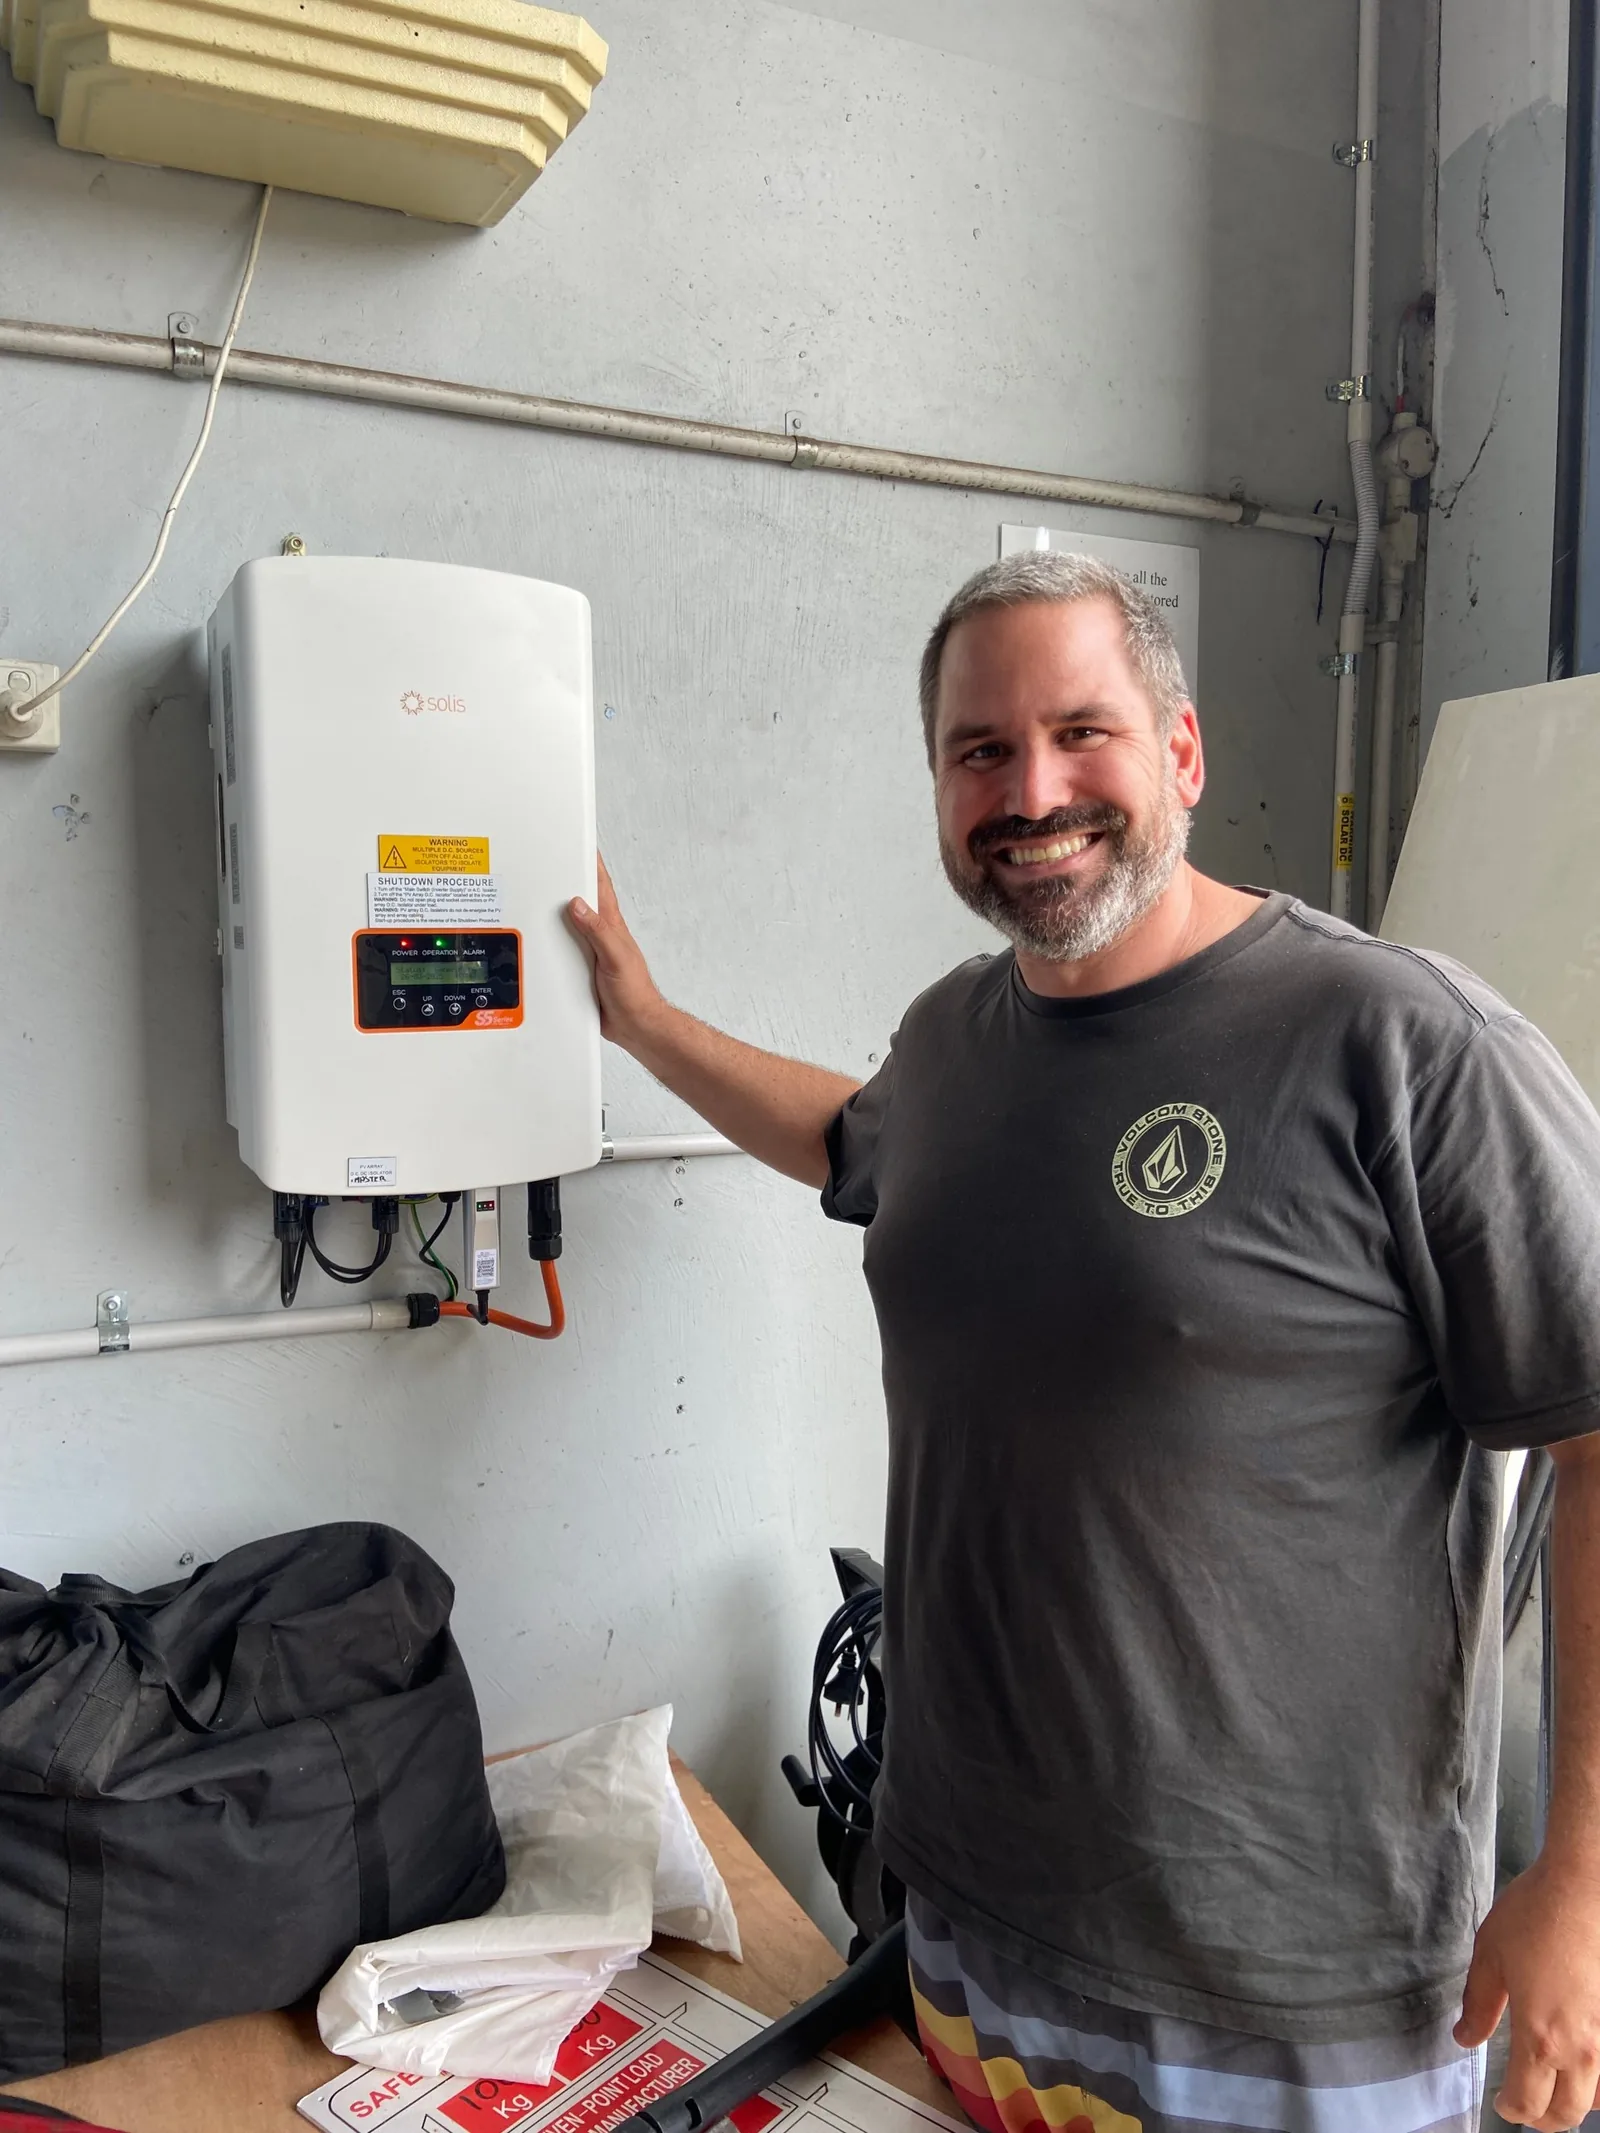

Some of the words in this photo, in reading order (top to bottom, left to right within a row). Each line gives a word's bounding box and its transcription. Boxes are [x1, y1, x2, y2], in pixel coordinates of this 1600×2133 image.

[1132, 570, 1147, 584] all
[1150, 572, 1168, 586] the
[1150, 594, 1179, 608] tored
[427, 693, 466, 713] solis
[1339, 809, 1350, 845] SOLAR
[428, 838, 468, 847] WARNING
[1338, 847, 1348, 862] DC
[378, 877, 433, 886] SHUTDOWN
[436, 878, 494, 887] PROCEDURE
[1117, 1104, 1187, 1154] VOLCOM
[1192, 1108, 1224, 1166] STONE
[1114, 1160, 1139, 1207] TRUE
[1144, 1202, 1169, 1216] TO
[1176, 1174, 1217, 1211] THIS
[577, 2033, 617, 2057] Kg
[458, 2078, 515, 2111] 10
[543, 2076, 630, 2133] VEN-POINT
[620, 2052, 665, 2085] LOAD
[492, 2093, 534, 2119] Kg
